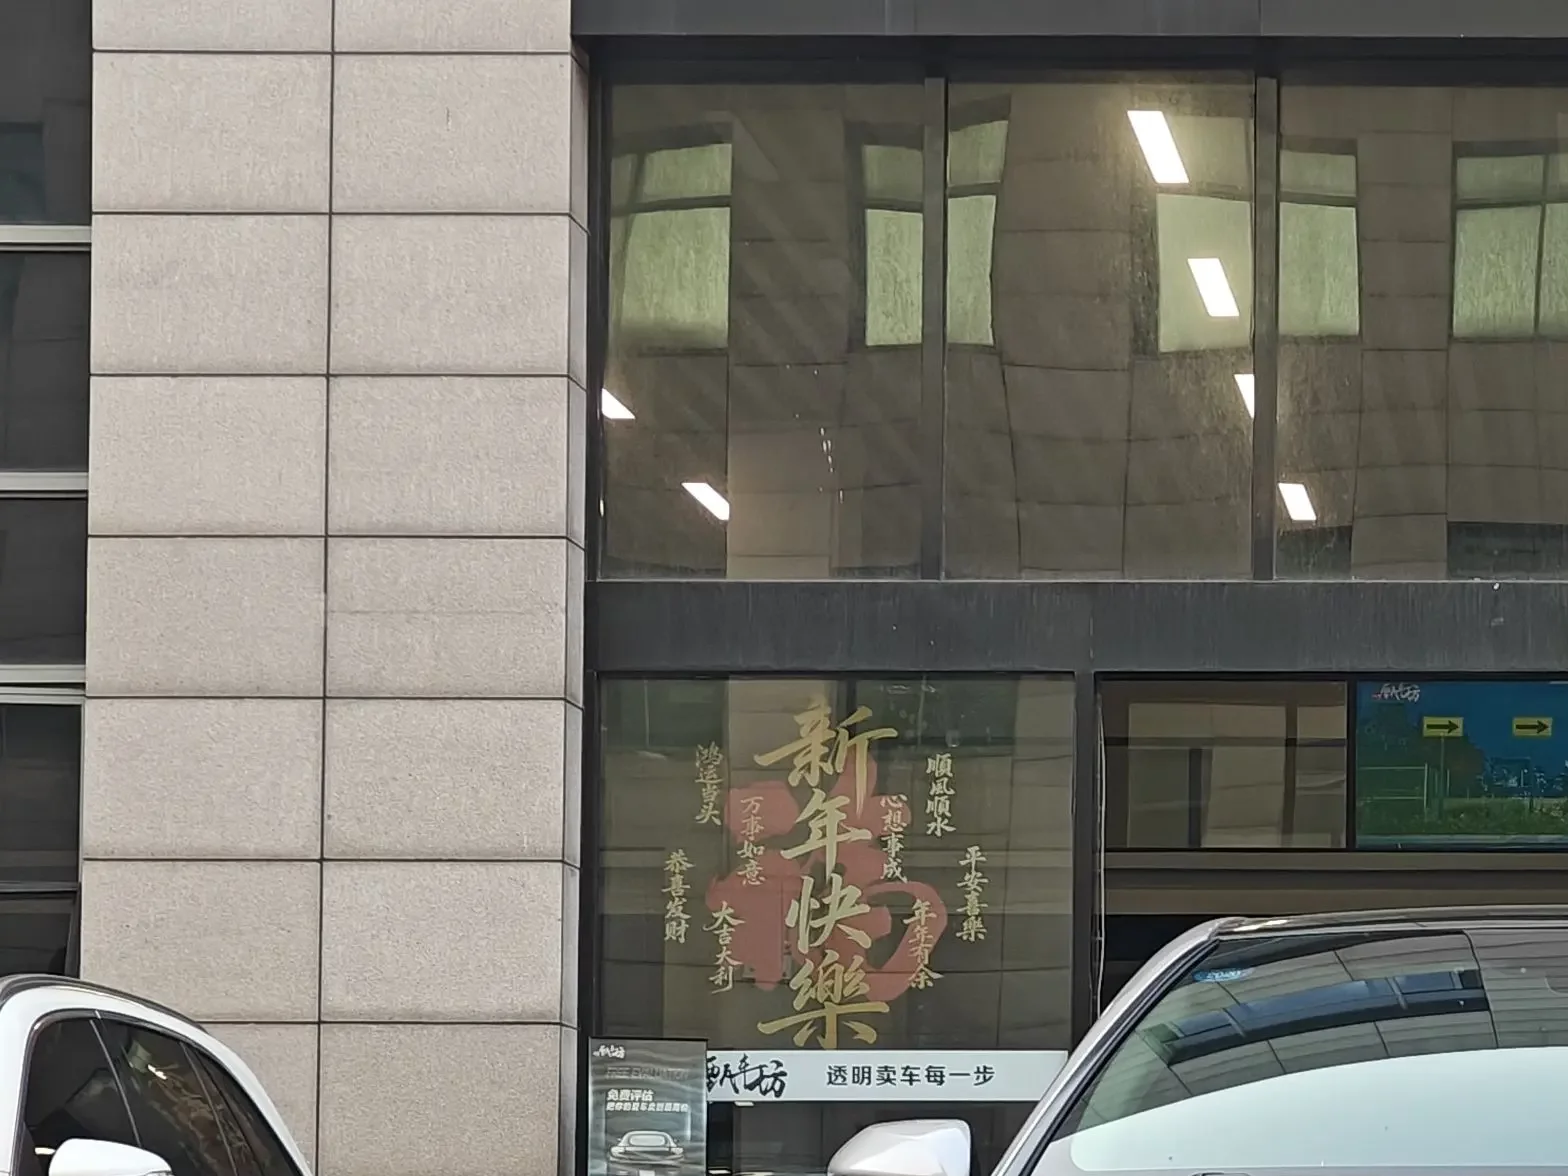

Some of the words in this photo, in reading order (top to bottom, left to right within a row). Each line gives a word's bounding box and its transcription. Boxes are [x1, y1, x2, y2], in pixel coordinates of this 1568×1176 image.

[736, 796, 766, 887] 万事如意
[753, 702, 899, 1051] 新年快樂
[879, 793, 908, 884] 心想事成
[662, 848, 696, 944] 恭喜发财
[702, 900, 747, 994] 大吉大利
[826, 1064, 996, 1087] 透明卖车每一步
